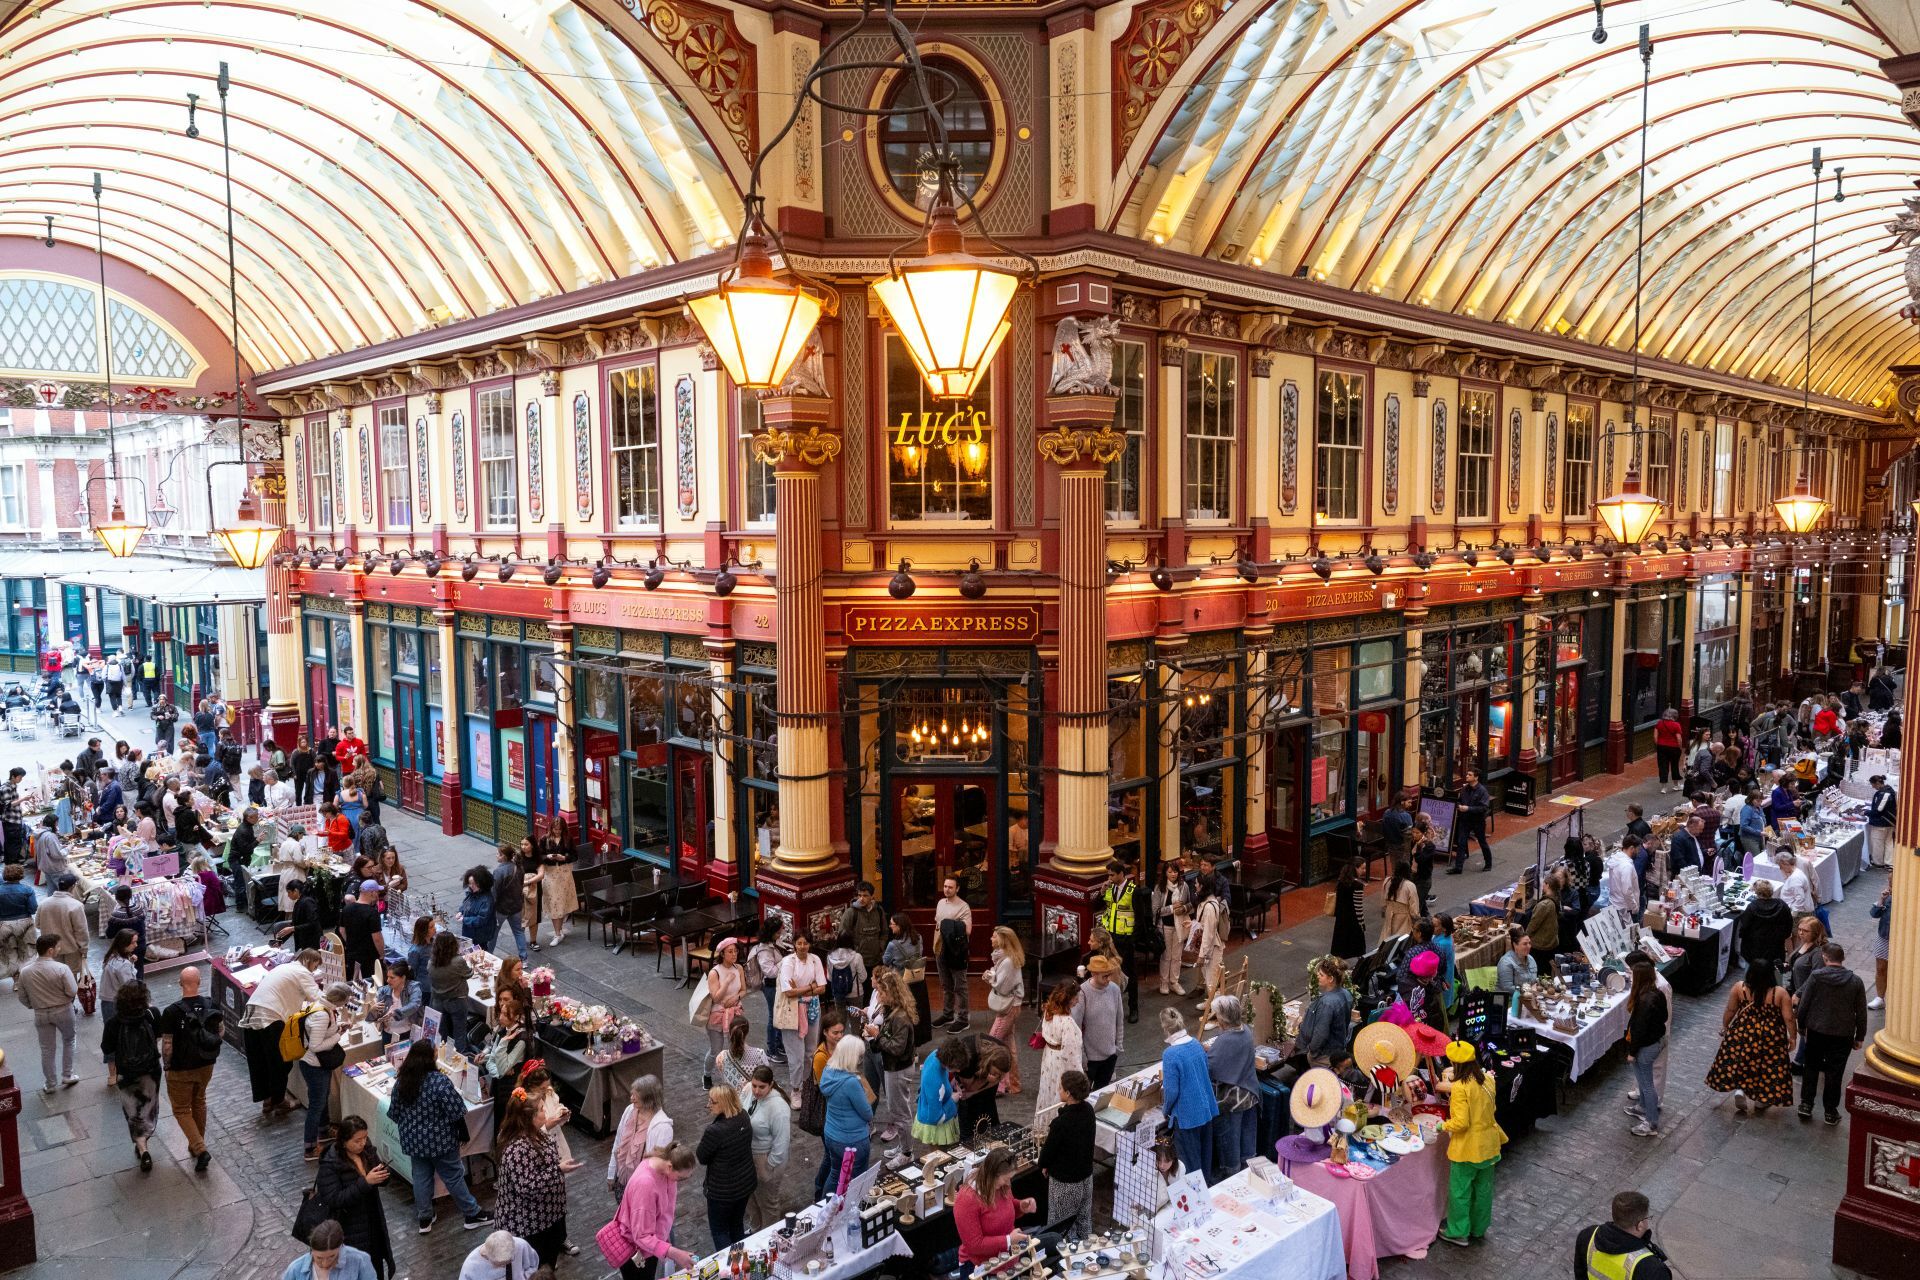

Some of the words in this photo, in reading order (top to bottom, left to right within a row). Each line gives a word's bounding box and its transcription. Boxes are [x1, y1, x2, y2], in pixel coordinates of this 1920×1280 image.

[894, 405, 986, 445] LUC'S
[1393, 588, 1404, 599] 20
[1459, 582, 1475, 592] FINE
[453, 590, 462, 600] 23
[1306, 590, 1374, 608] PIZZAEXPRESS
[1266, 599, 1278, 611] 20
[621, 604, 704, 622] PIZZAEXPRESS
[855, 616, 1029, 631] PIZZAEXPRESS
